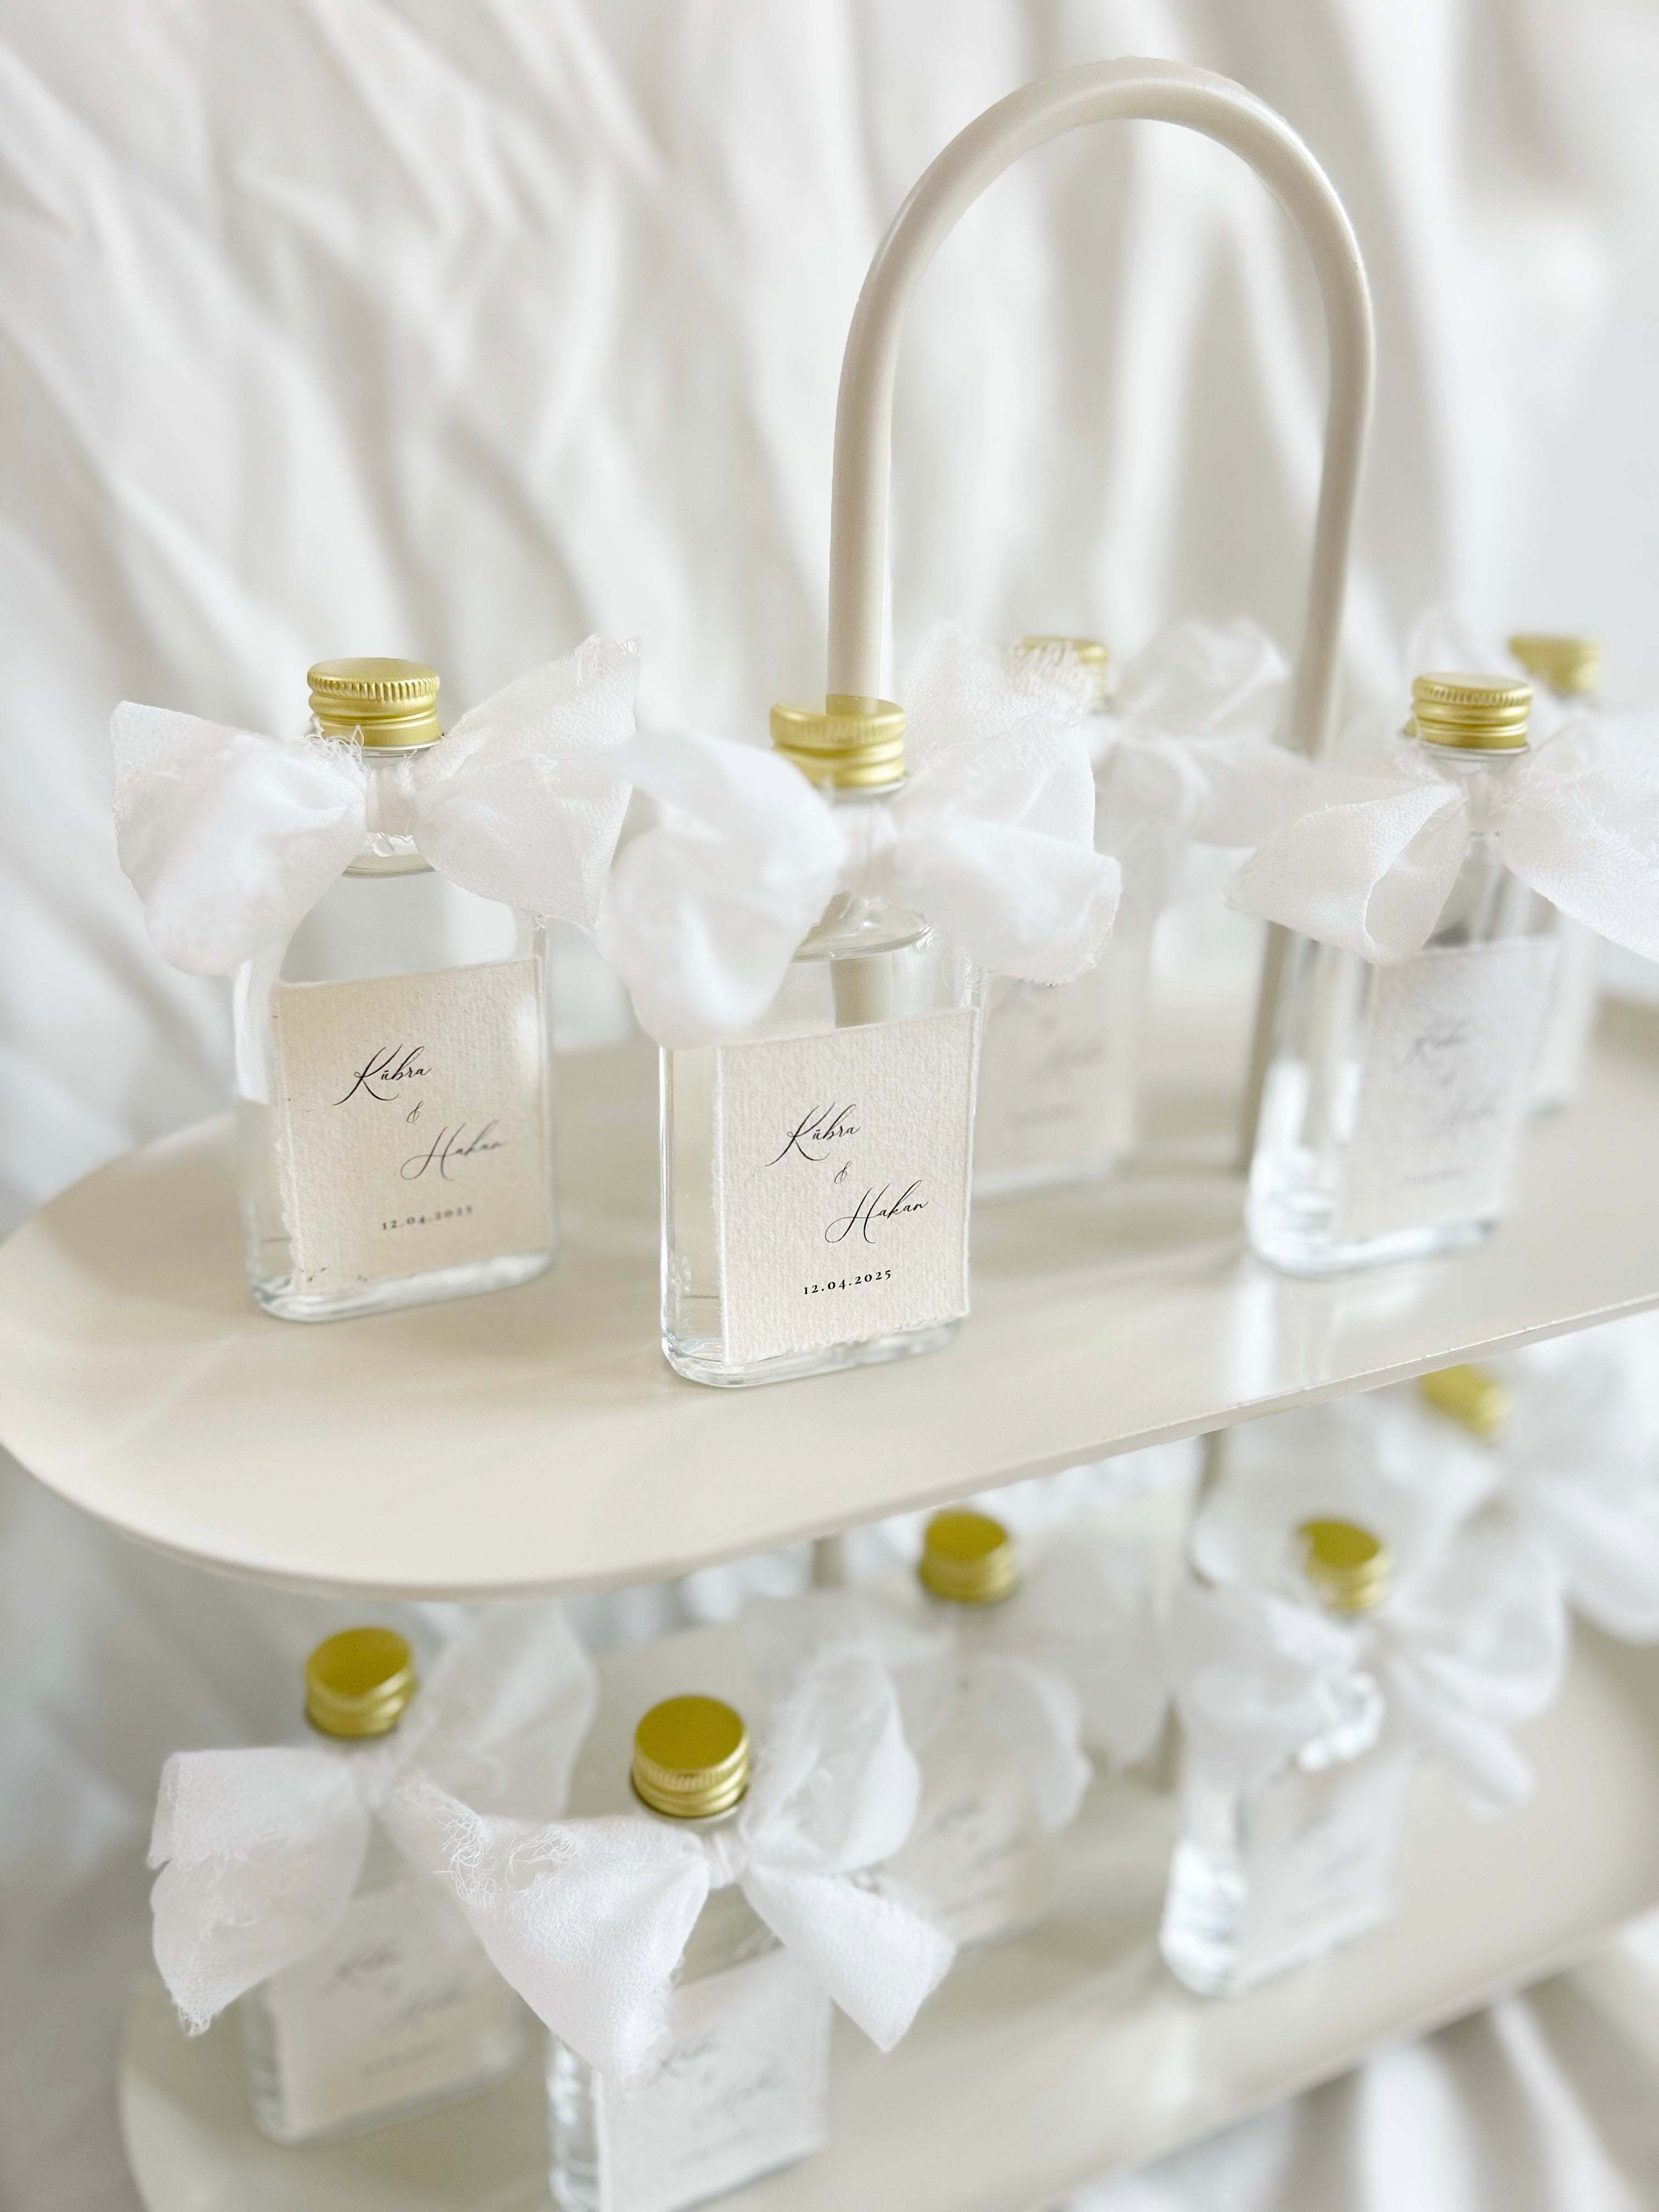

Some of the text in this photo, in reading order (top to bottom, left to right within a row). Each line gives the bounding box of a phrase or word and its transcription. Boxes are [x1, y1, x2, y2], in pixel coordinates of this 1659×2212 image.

[406, 1101, 424, 1123] &
[834, 1160, 851, 1183] &
[825, 1180, 929, 1244] Hakan
[804, 1269, 891, 1295] 12.04.2025
